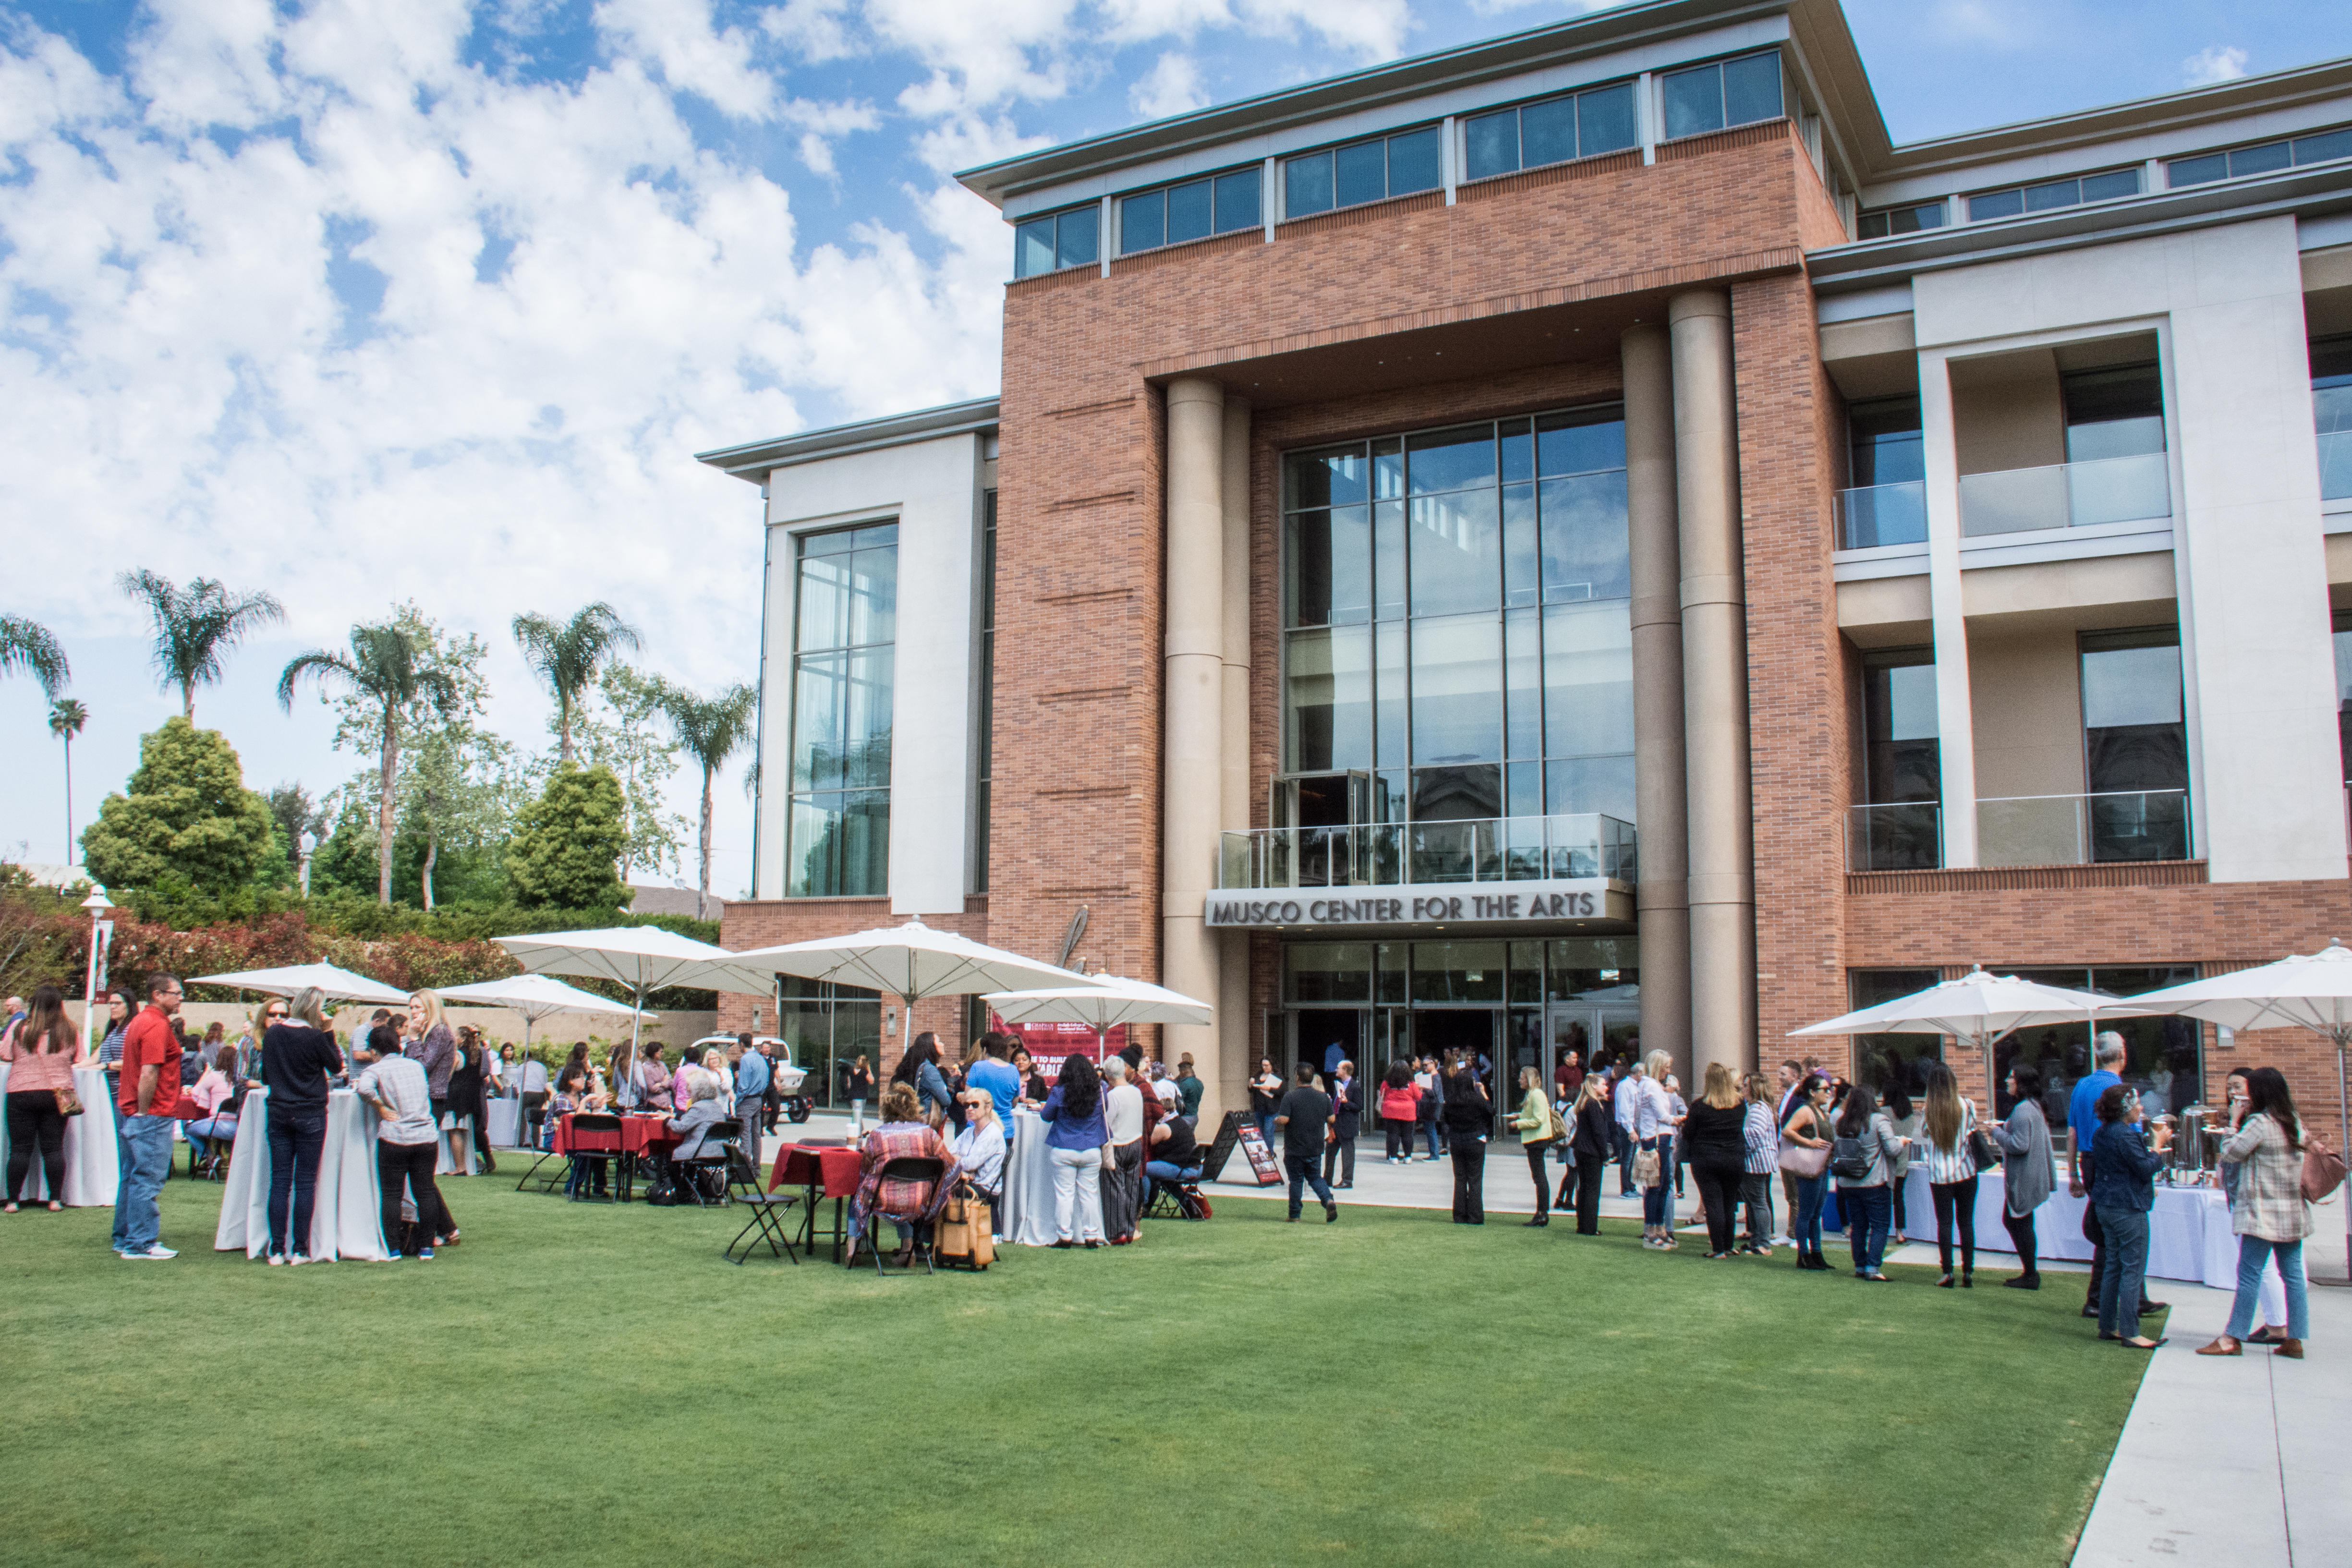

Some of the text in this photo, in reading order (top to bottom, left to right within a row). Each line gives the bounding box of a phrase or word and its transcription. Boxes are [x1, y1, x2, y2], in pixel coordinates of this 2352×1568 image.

[1212, 892, 1594, 924] MUSCO CENTER FOR THE ARTS
